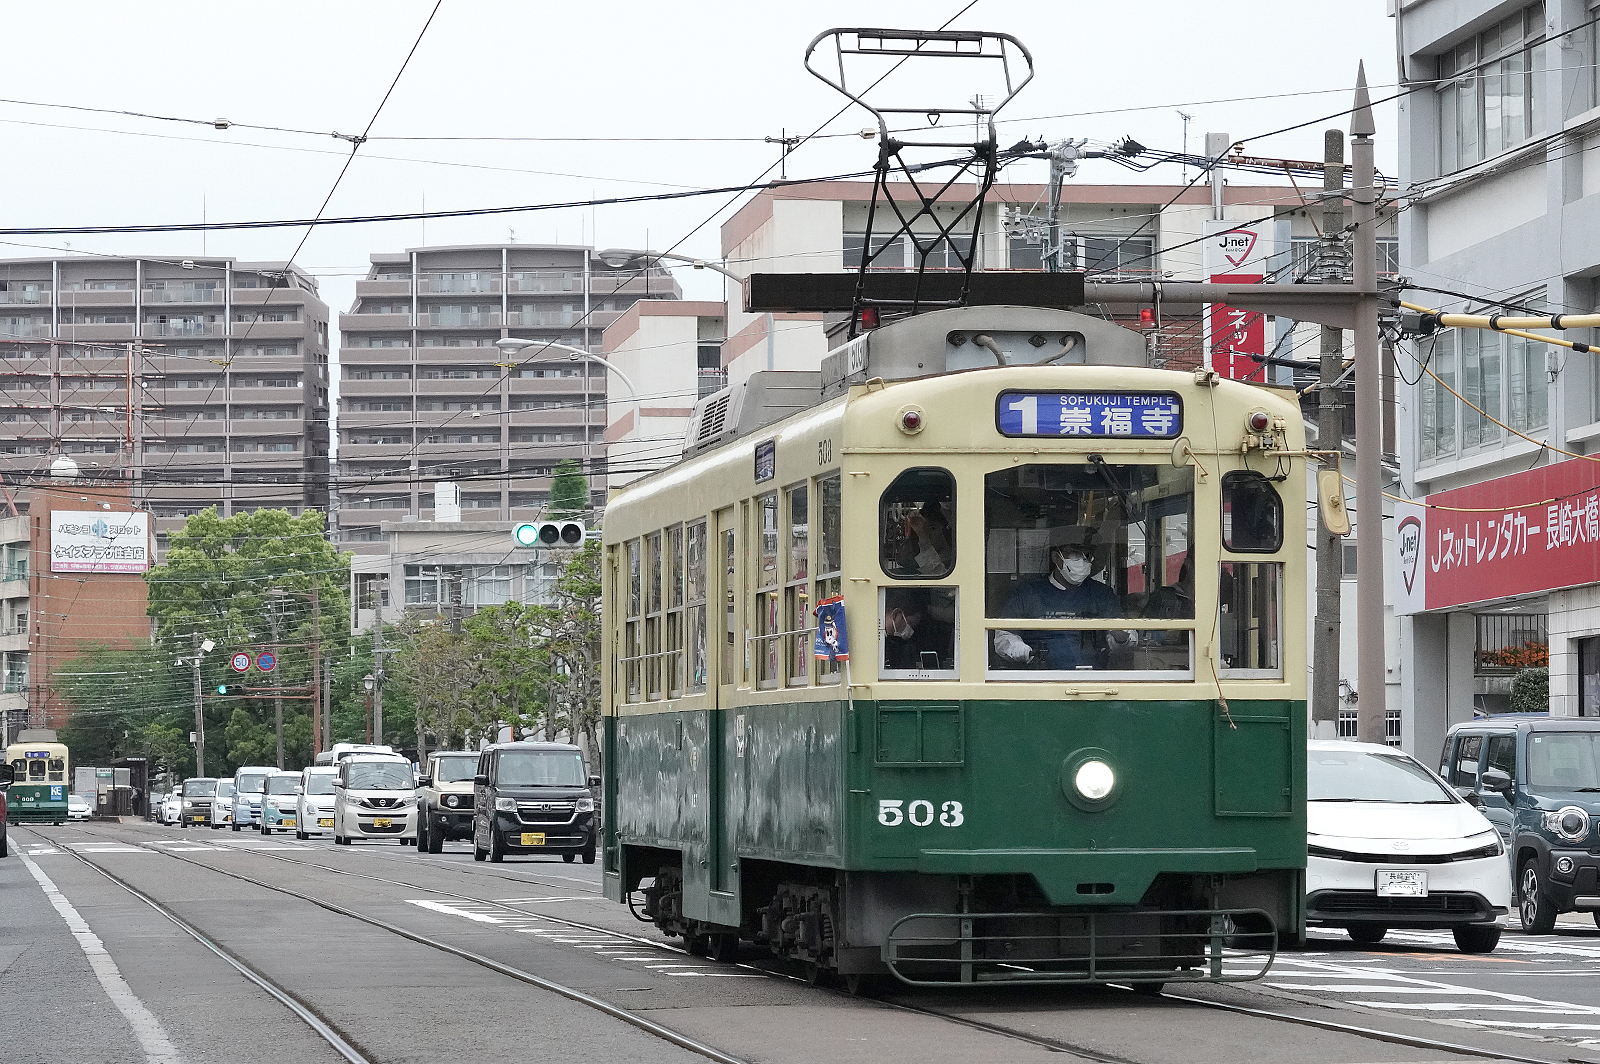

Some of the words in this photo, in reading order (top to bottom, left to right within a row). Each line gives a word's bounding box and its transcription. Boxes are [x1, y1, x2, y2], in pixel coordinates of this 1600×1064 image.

[1060, 396, 1120, 406] SOFUKUJI
[1125, 396, 1174, 406] TEMPLE
[1009, 396, 1038, 434] 1
[1060, 407, 1173, 434] 崇福寺
[818, 439, 832, 466] 503
[58, 524, 90, 535] パチンコ
[109, 525, 141, 535] スロット
[1431, 511, 1541, 573] Jネットレンタカー
[1546, 494, 1600, 550] 長崎大橋
[235, 657, 247, 667] 50
[878, 799, 964, 827] 503
